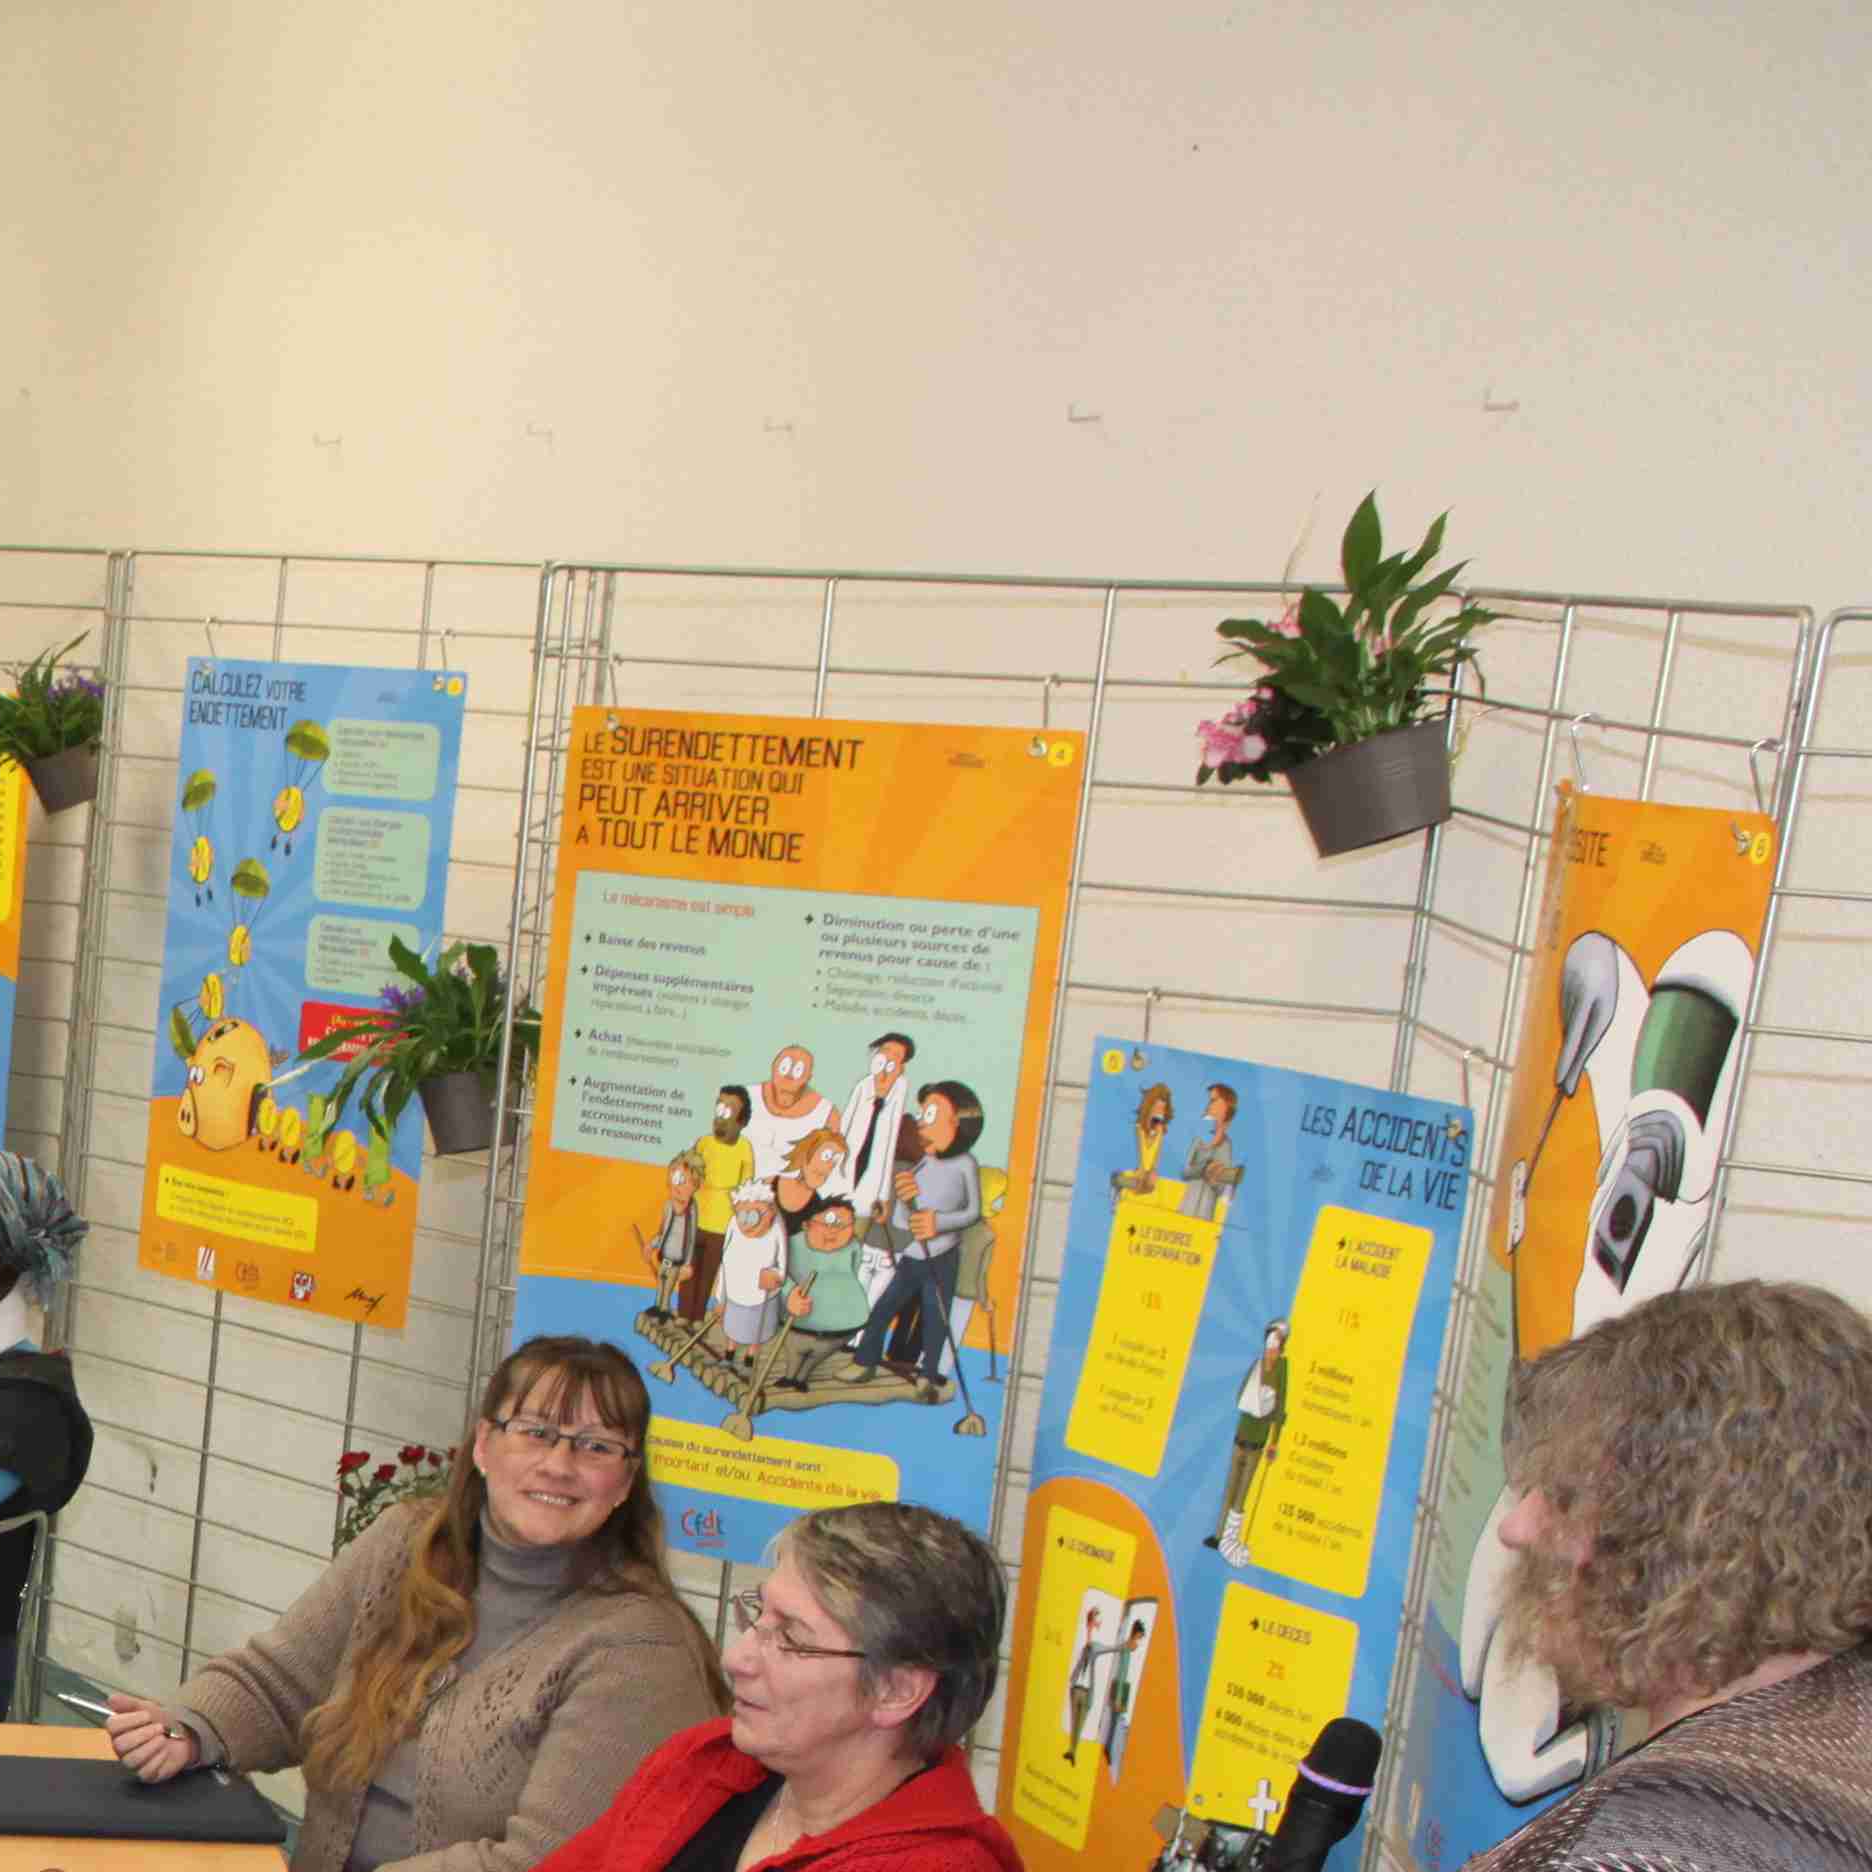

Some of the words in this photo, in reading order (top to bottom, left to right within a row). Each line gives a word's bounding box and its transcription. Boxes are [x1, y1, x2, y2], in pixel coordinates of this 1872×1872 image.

[191, 670, 263, 698] CALCULEZ
[265, 679, 308, 702] VOTRE
[188, 700, 288, 731] ENDETTEMENT
[583, 731, 606, 755] LE
[610, 725, 864, 771] SURENDETTEMENT
[580, 758, 618, 782] EST
[622, 762, 656, 785] UNE
[662, 763, 767, 791] SITUATION
[767, 770, 805, 795] QUI
[577, 783, 647, 815] PEUT
[653, 790, 770, 827] ARRIVER
[598, 817, 665, 851] TOUT
[671, 824, 701, 855] LE
[706, 827, 805, 864] MONDE
[822, 912, 906, 933] Diminution
[909, 923, 928, 934] ou
[931, 925, 974, 940] perte
[598, 932, 634, 948] Baisse
[637, 937, 657, 951] des
[660, 942, 706, 956] revenus
[820, 933, 839, 944] ou
[843, 933, 907, 949] plusieurs
[911, 940, 968, 955] sources
[972, 942, 990, 955] de
[818, 949, 873, 964] revenus
[877, 952, 912, 968] pour
[917, 956, 957, 970] cause
[653, 971, 755, 993] supplémentaires
[588, 1027, 624, 1044] Achat
[583, 1075, 667, 1099] Augmentation
[669, 1087, 685, 1100] de
[580, 1108, 664, 1130] accroissement
[667, 1105, 693, 1119] sans
[578, 1122, 598, 1136] des
[600, 1128, 662, 1145] ressources
[1299, 1103, 1337, 1137] LES
[1338, 1106, 1469, 1168] ACCIDENTS
[1359, 1160, 1388, 1193] DE
[1387, 1167, 1414, 1200] LA
[1423, 1167, 1462, 1211] VIE
